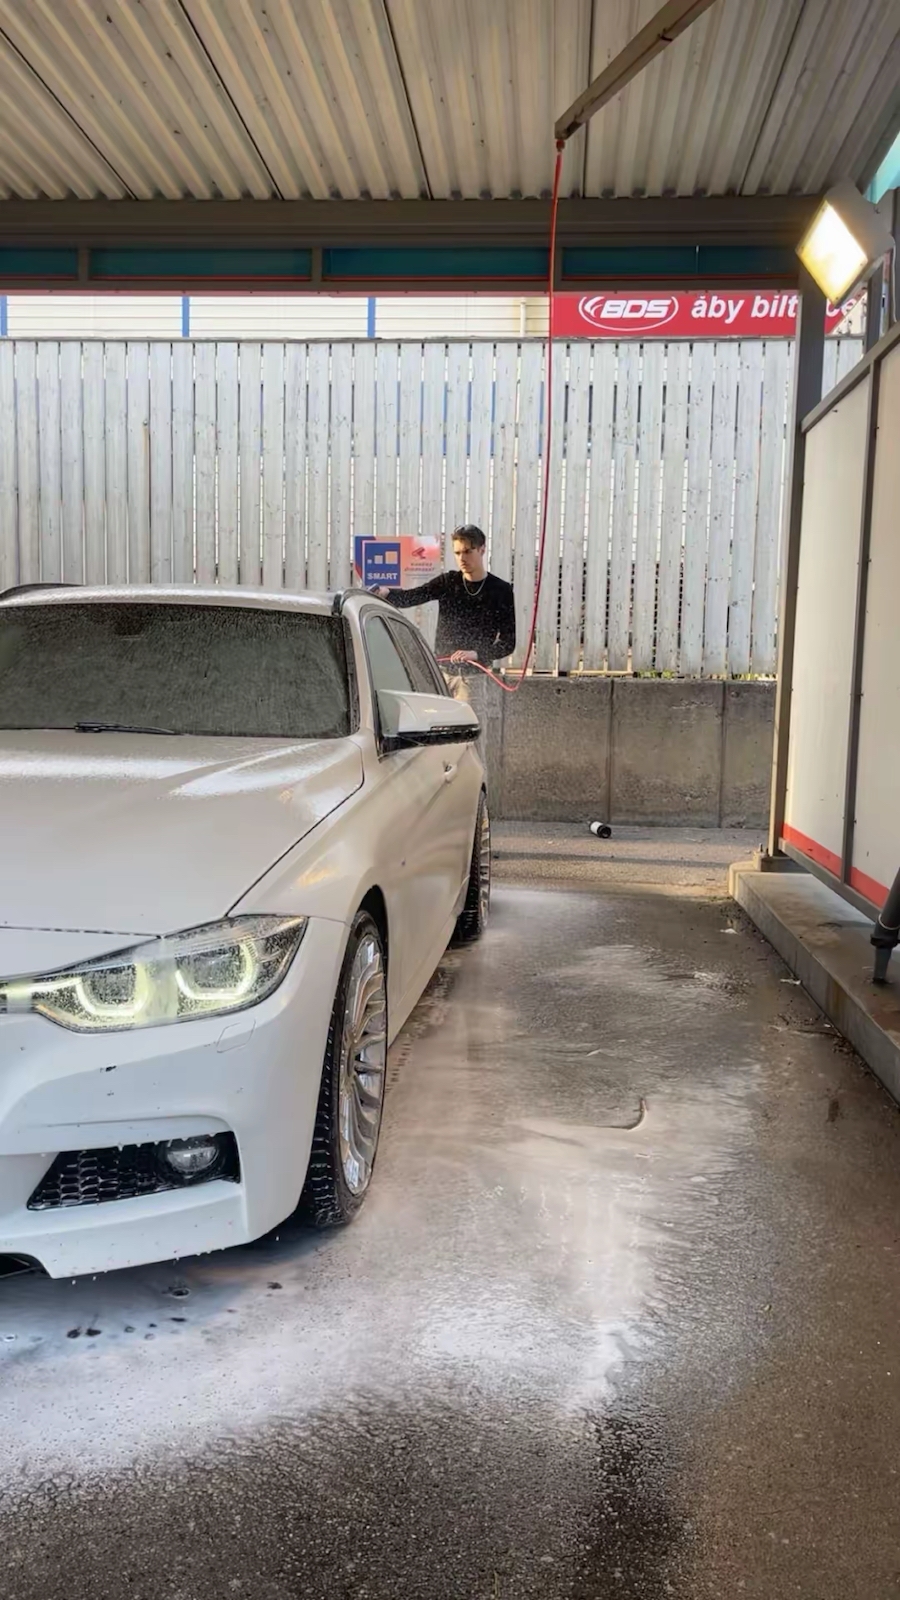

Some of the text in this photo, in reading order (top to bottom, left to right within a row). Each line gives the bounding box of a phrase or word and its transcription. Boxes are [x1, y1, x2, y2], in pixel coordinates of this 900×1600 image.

[600, 299, 672, 318] BDS
[691, 295, 745, 324] åby
[751, 295, 798, 318] bilt
[367, 572, 398, 580] SMART
